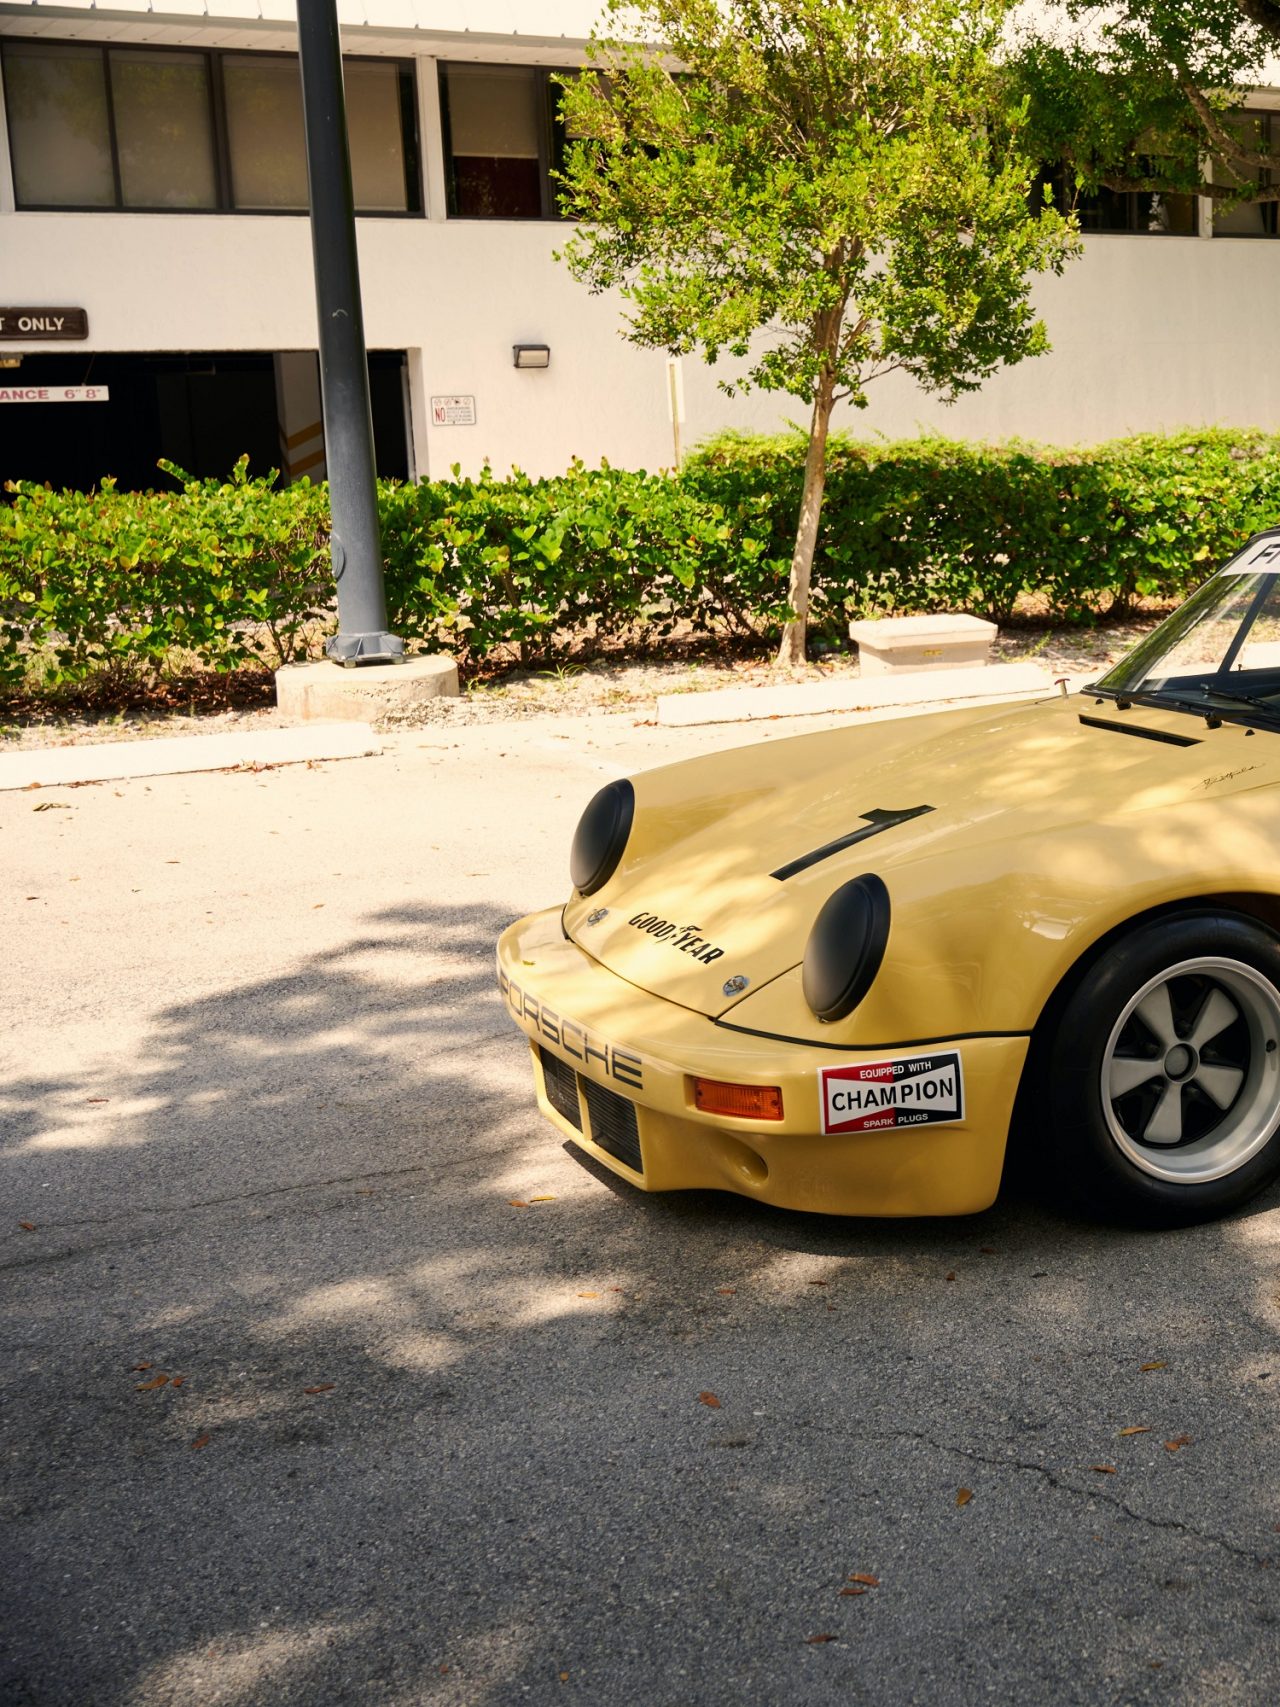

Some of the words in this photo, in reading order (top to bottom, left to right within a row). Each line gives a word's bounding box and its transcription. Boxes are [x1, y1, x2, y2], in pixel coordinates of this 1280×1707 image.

[18, 317, 64, 331] ONLY
[0, 389, 48, 400] ANCE
[435, 407, 446, 422] NO
[628, 911, 725, 965] GOODYEAR
[500, 967, 644, 1090] PORSCHE
[860, 1065, 905, 1080] EQUIPPED
[908, 1061, 932, 1073] WITH
[832, 1077, 954, 1112] CHAMPION
[863, 1117, 894, 1129] SPARK
[898, 1113, 929, 1124] PLUGS
